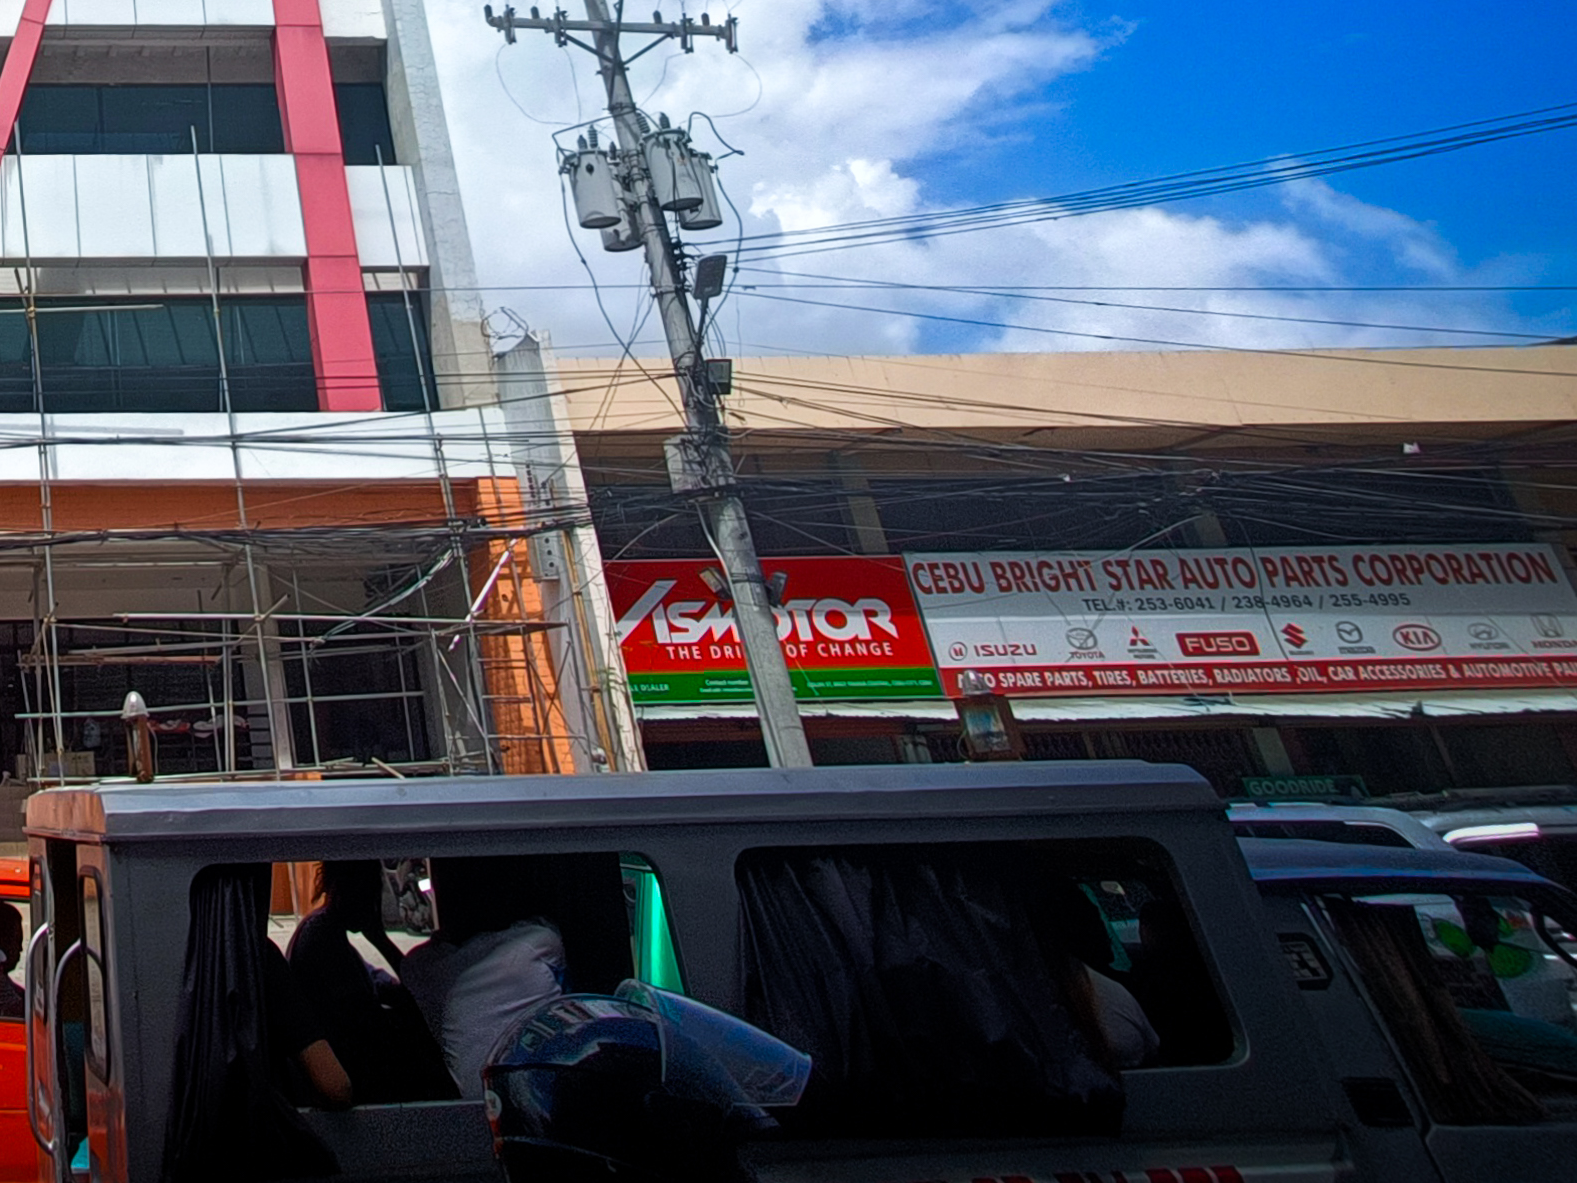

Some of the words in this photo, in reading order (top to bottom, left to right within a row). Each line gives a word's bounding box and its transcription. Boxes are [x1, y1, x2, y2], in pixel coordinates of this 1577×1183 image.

[911, 560, 984, 595] CEBU
[989, 558, 1097, 593] BRIGHT
[1104, 557, 1176, 592] STAR
[1180, 555, 1257, 590] AUTO
[1259, 554, 1349, 588] PARTS
[1352, 551, 1557, 587] CORPORATION
[1135, 596, 1214, 612] 253-6041
[1232, 594, 1313, 610] 238-4964
[1329, 592, 1411, 608] 255-4995
[1185, 636, 1250, 653] FUSO
[1400, 629, 1432, 646] KIA
[666, 646, 702, 660] THE
[785, 643, 809, 658] OF
[816, 642, 894, 658] CHANGE
[974, 644, 1037, 657] ISUZU
[1070, 651, 1104, 659] TOYOTA
[999, 671, 1043, 688] SPARE
[1046, 670, 1093, 688] PARTS,
[1093, 669, 1136, 687] TIRES,
[1137, 668, 1213, 686] BATTERIES,
[1215, 666, 1291, 684] RADIATORS
[1327, 665, 1355, 682] CAR
[1360, 663, 1444, 681] ACCESSORIES
[1448, 663, 1458, 679] &
[1462, 661, 1553, 679] AUTOMOTIVE
[1248, 778, 1340, 797] GOODRIDE
